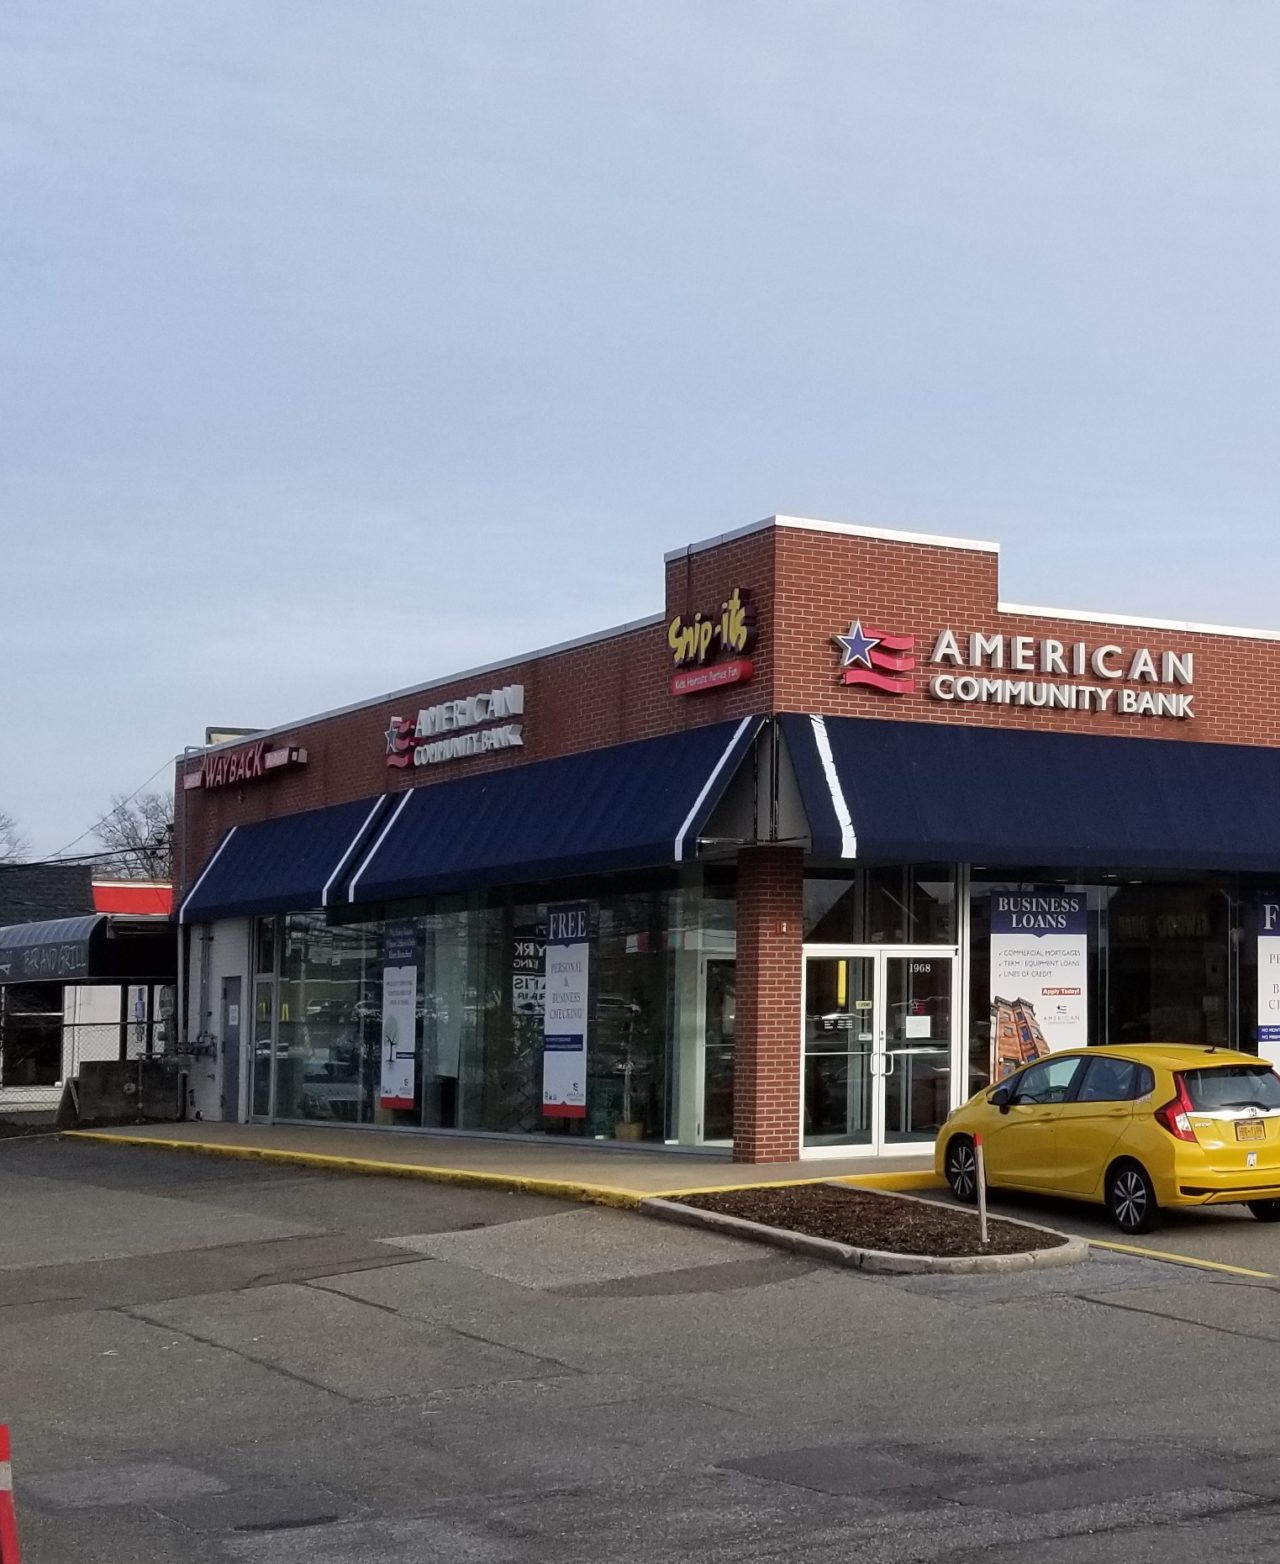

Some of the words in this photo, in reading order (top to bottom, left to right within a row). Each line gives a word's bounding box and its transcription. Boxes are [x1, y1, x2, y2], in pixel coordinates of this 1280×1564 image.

[668, 588, 748, 662] Snip-its
[931, 629, 1194, 685] AMERICAN
[930, 675, 1113, 711] COMMUNITY
[1117, 689, 1195, 718] BANK
[415, 684, 524, 738] AMERICAN
[414, 731, 486, 766] COMMUNITY
[481, 723, 524, 752] BANK
[203, 742, 264, 789] WAYBACK
[999, 897, 1080, 913] BUSINESS
[548, 910, 587, 940] FREE
[1011, 913, 1067, 929] LOANS
[551, 962, 583, 974] PERSONAL
[909, 963, 931, 973] 1968
[1025, 960, 1059, 968] EQUIPMENT
[1003, 970, 1020, 978] LINES
[1031, 970, 1052, 978] CREDIT
[552, 992, 581, 1004] BUSINESS
[550, 1008, 583, 1020] CHECKING
